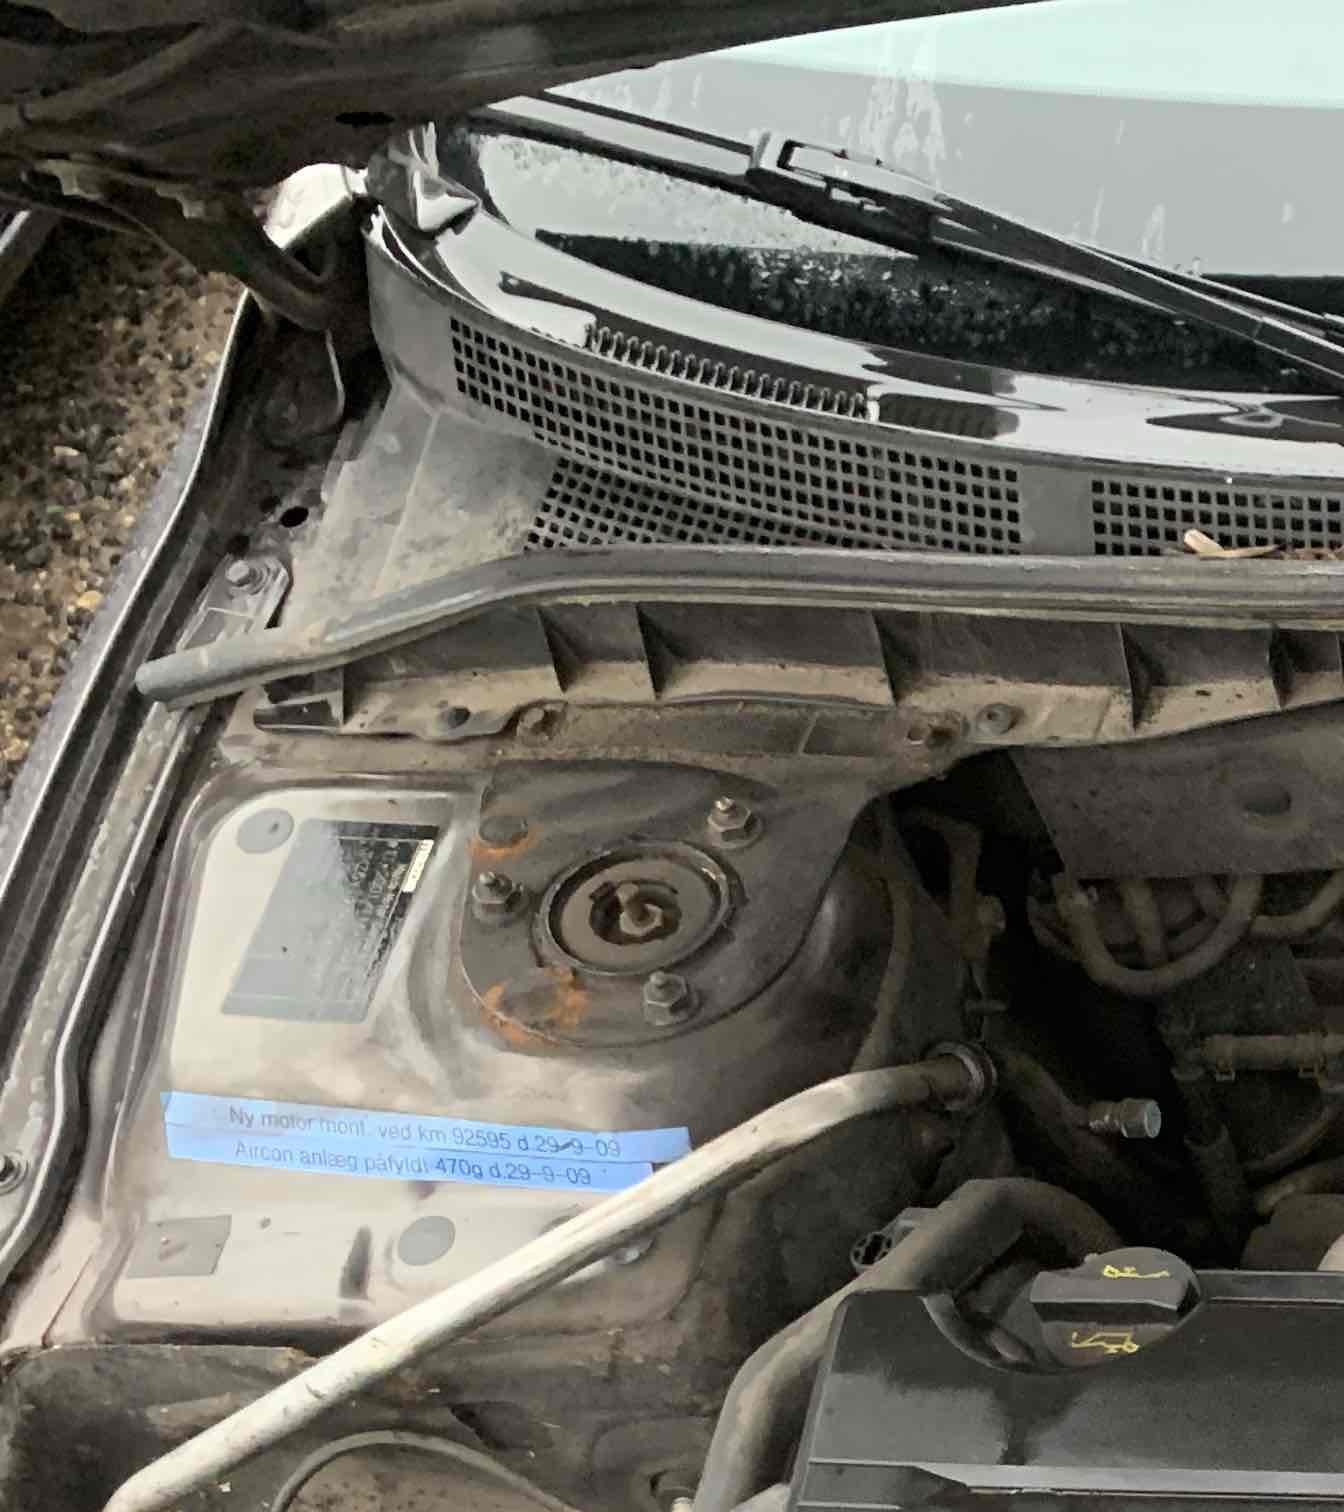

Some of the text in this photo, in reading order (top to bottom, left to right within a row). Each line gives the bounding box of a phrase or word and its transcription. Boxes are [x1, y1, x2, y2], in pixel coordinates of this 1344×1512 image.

[229, 1105, 255, 1129] Ny
[261, 1111, 314, 1130] motor
[378, 1123, 412, 1141] ved
[418, 1124, 447, 1144] km
[452, 1126, 512, 1150] 92595
[235, 1138, 293, 1163] Aircon
[299, 1147, 358, 1173] anlæg
[435, 1156, 484, 1180] 470g
